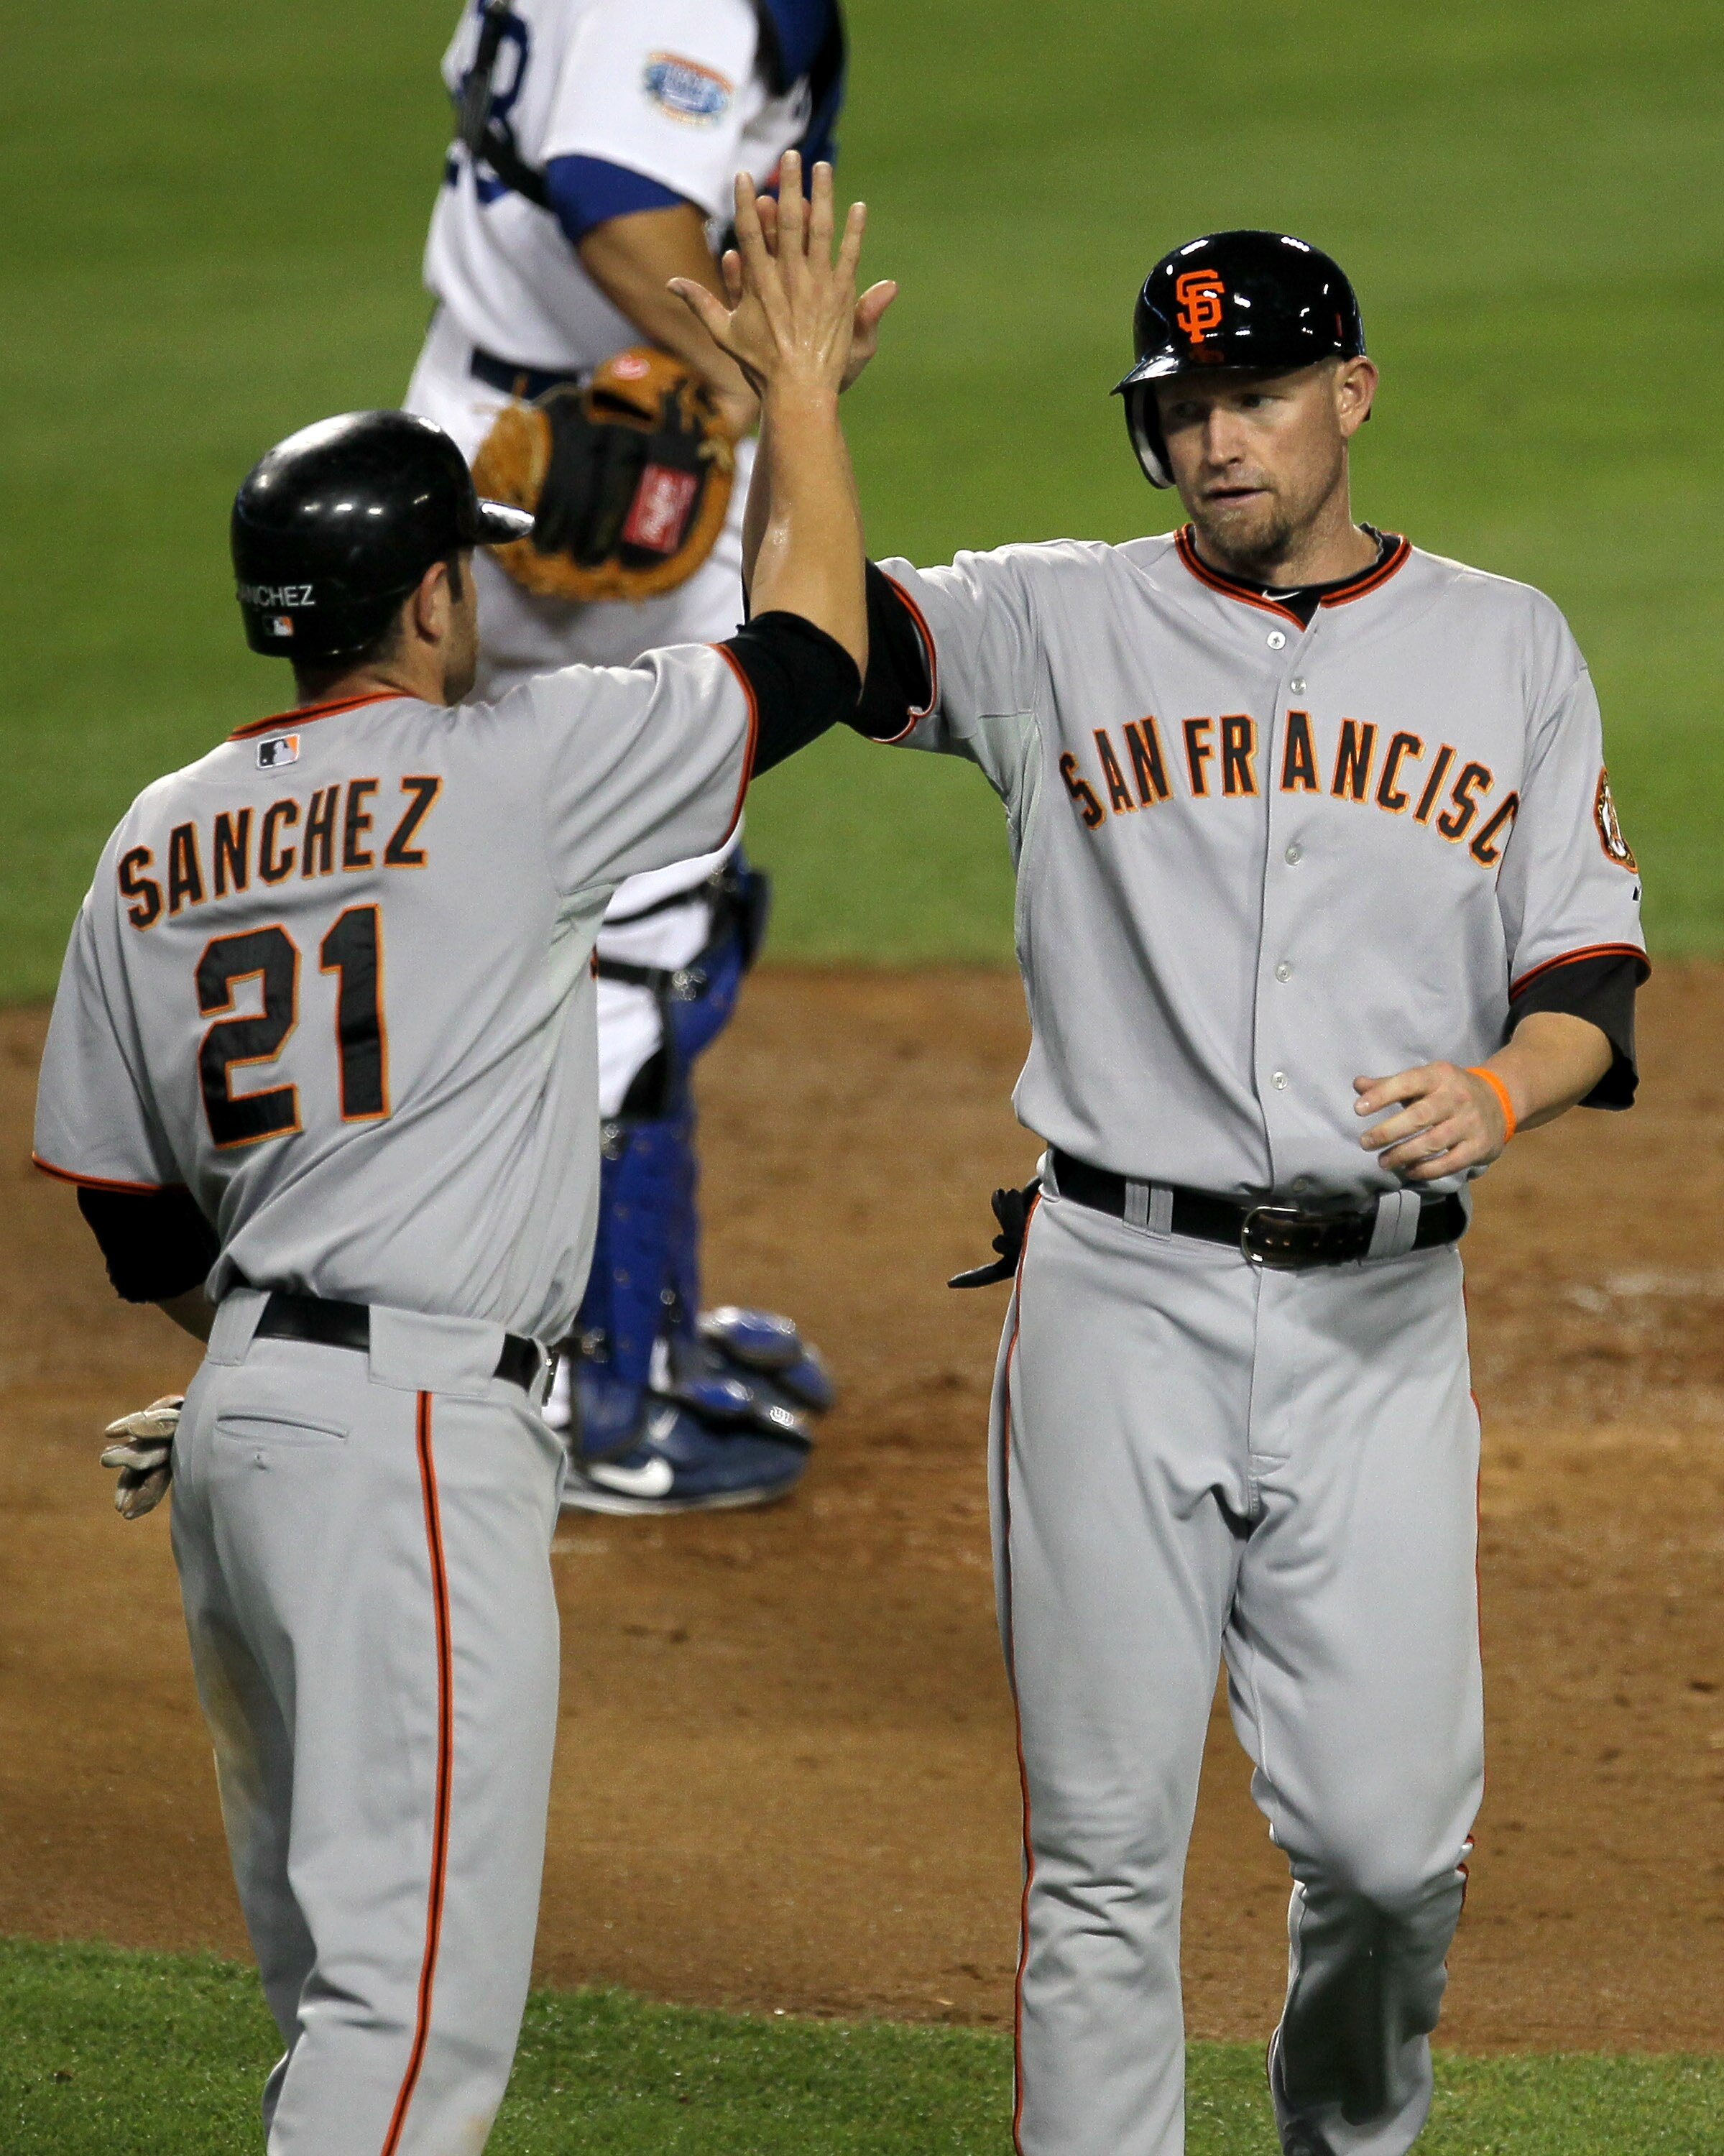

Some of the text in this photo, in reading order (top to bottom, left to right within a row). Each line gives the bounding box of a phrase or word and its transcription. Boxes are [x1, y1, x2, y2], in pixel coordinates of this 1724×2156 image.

[1176, 269, 1225, 343] SF
[118, 775, 443, 931] SANCHEZ
[1059, 714, 1173, 831] SAN
[1181, 709, 1520, 869] FRANCISC
[194, 901, 392, 1151] 21
